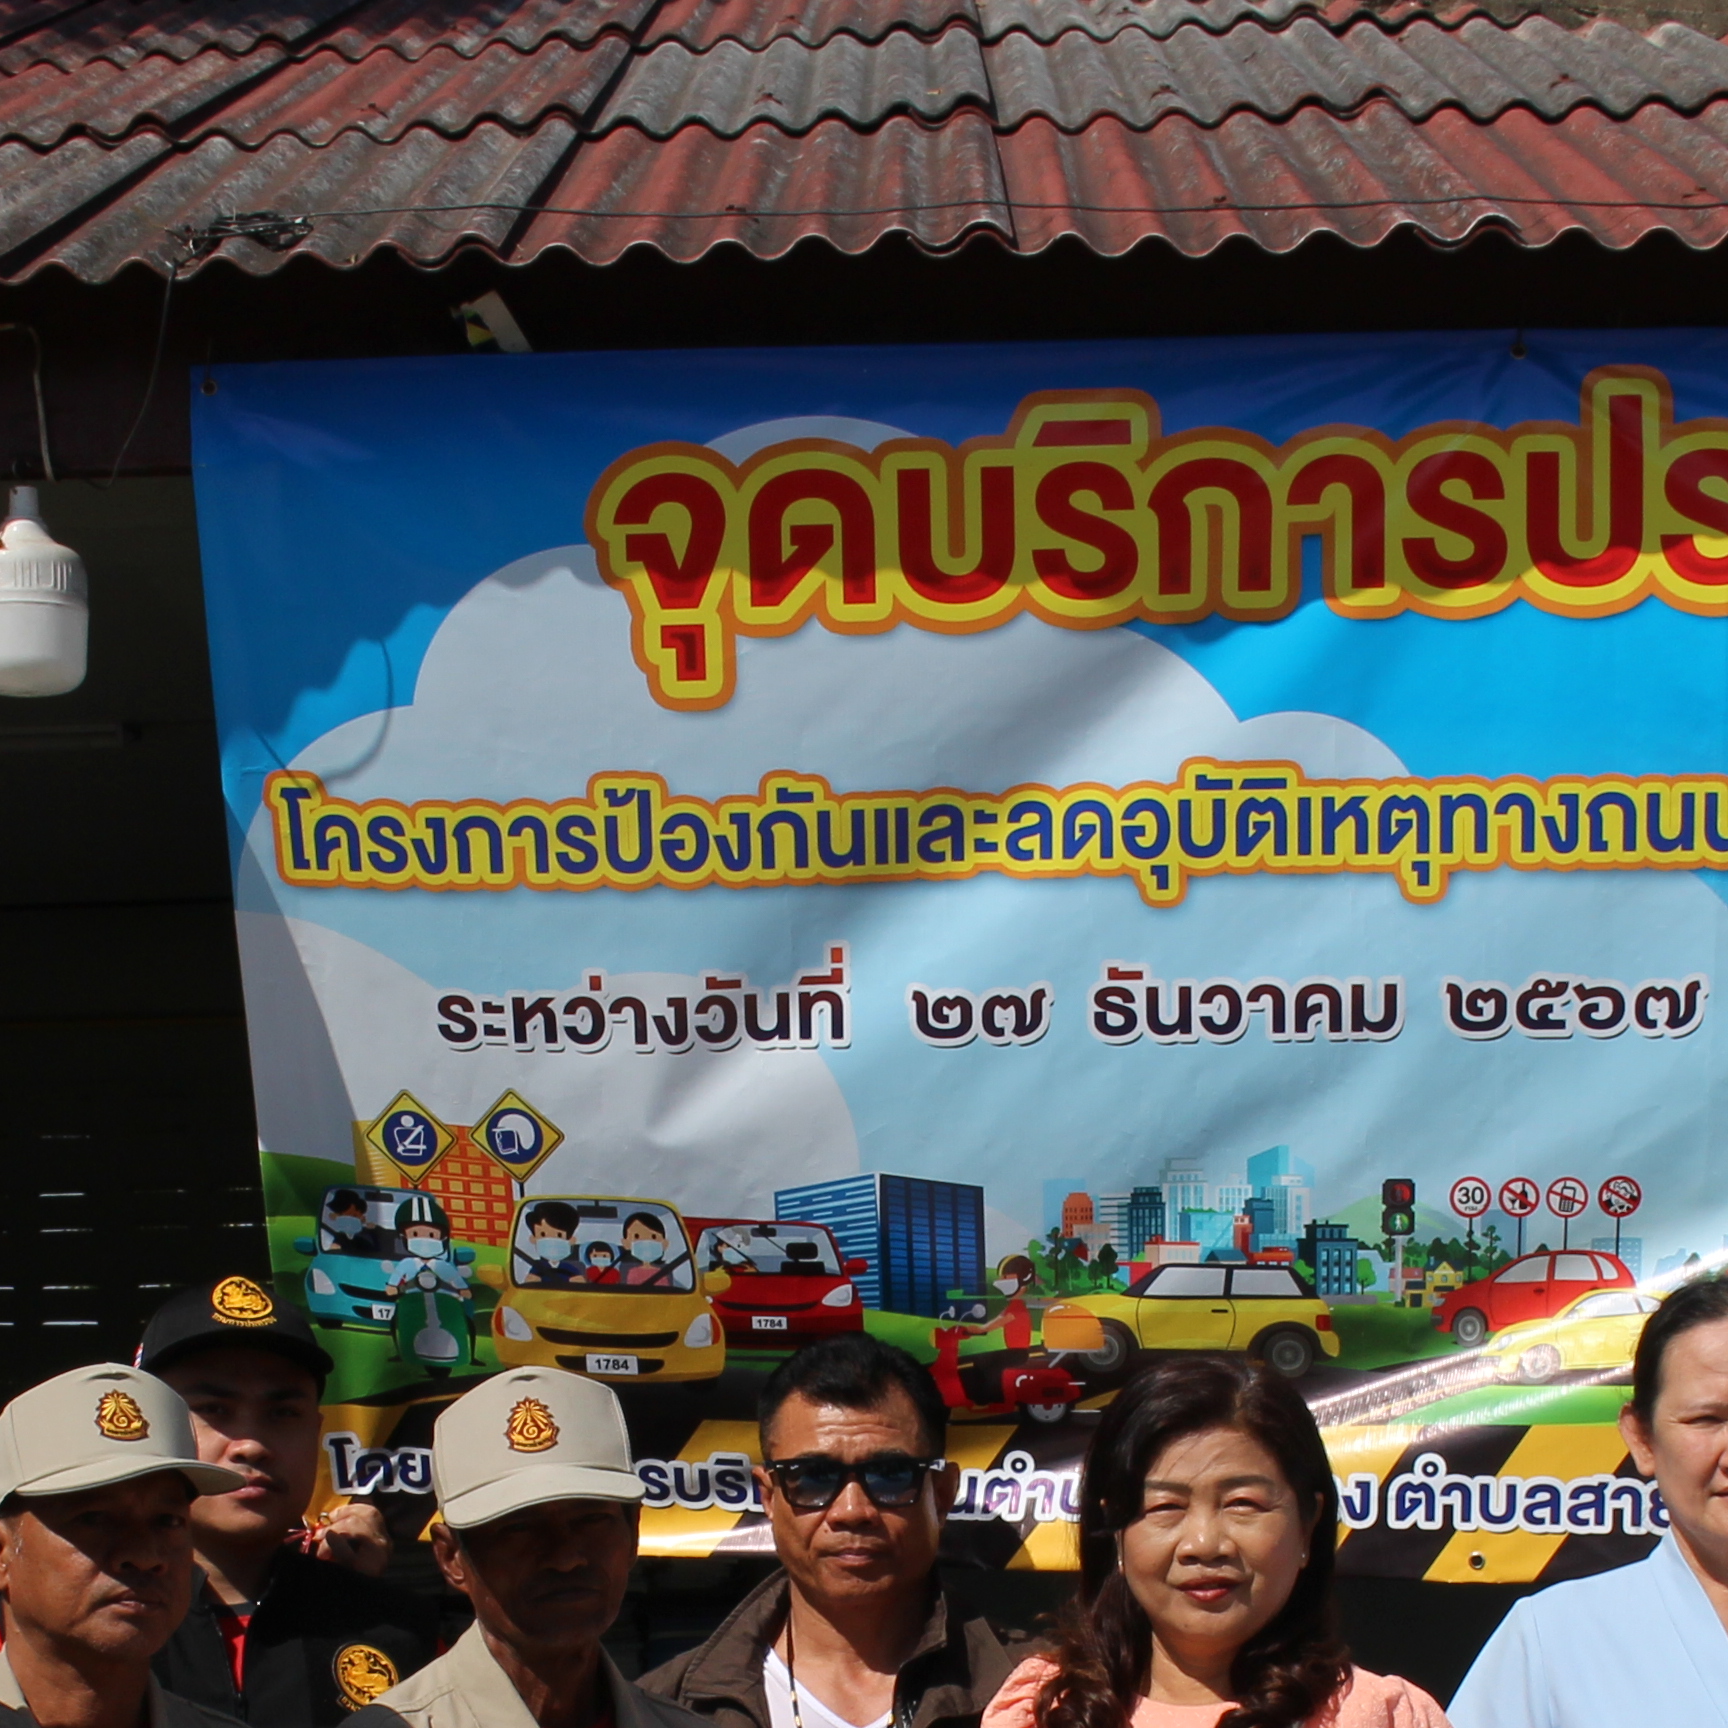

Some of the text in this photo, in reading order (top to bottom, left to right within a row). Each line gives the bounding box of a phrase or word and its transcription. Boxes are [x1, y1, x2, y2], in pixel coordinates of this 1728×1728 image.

[436, 945, 846, 1047] ระหว่างวันที่
[911, 985, 1048, 1039] ๒๗
[1091, 966, 1399, 1036] ธันวาคม
[1444, 976, 1703, 1035] ๒๕๖๗
[1458, 1186, 1484, 1204] 30
[755, 1317, 784, 1329] 1784
[593, 1357, 630, 1373] 1784
[326, 1434, 433, 1491] โดย
